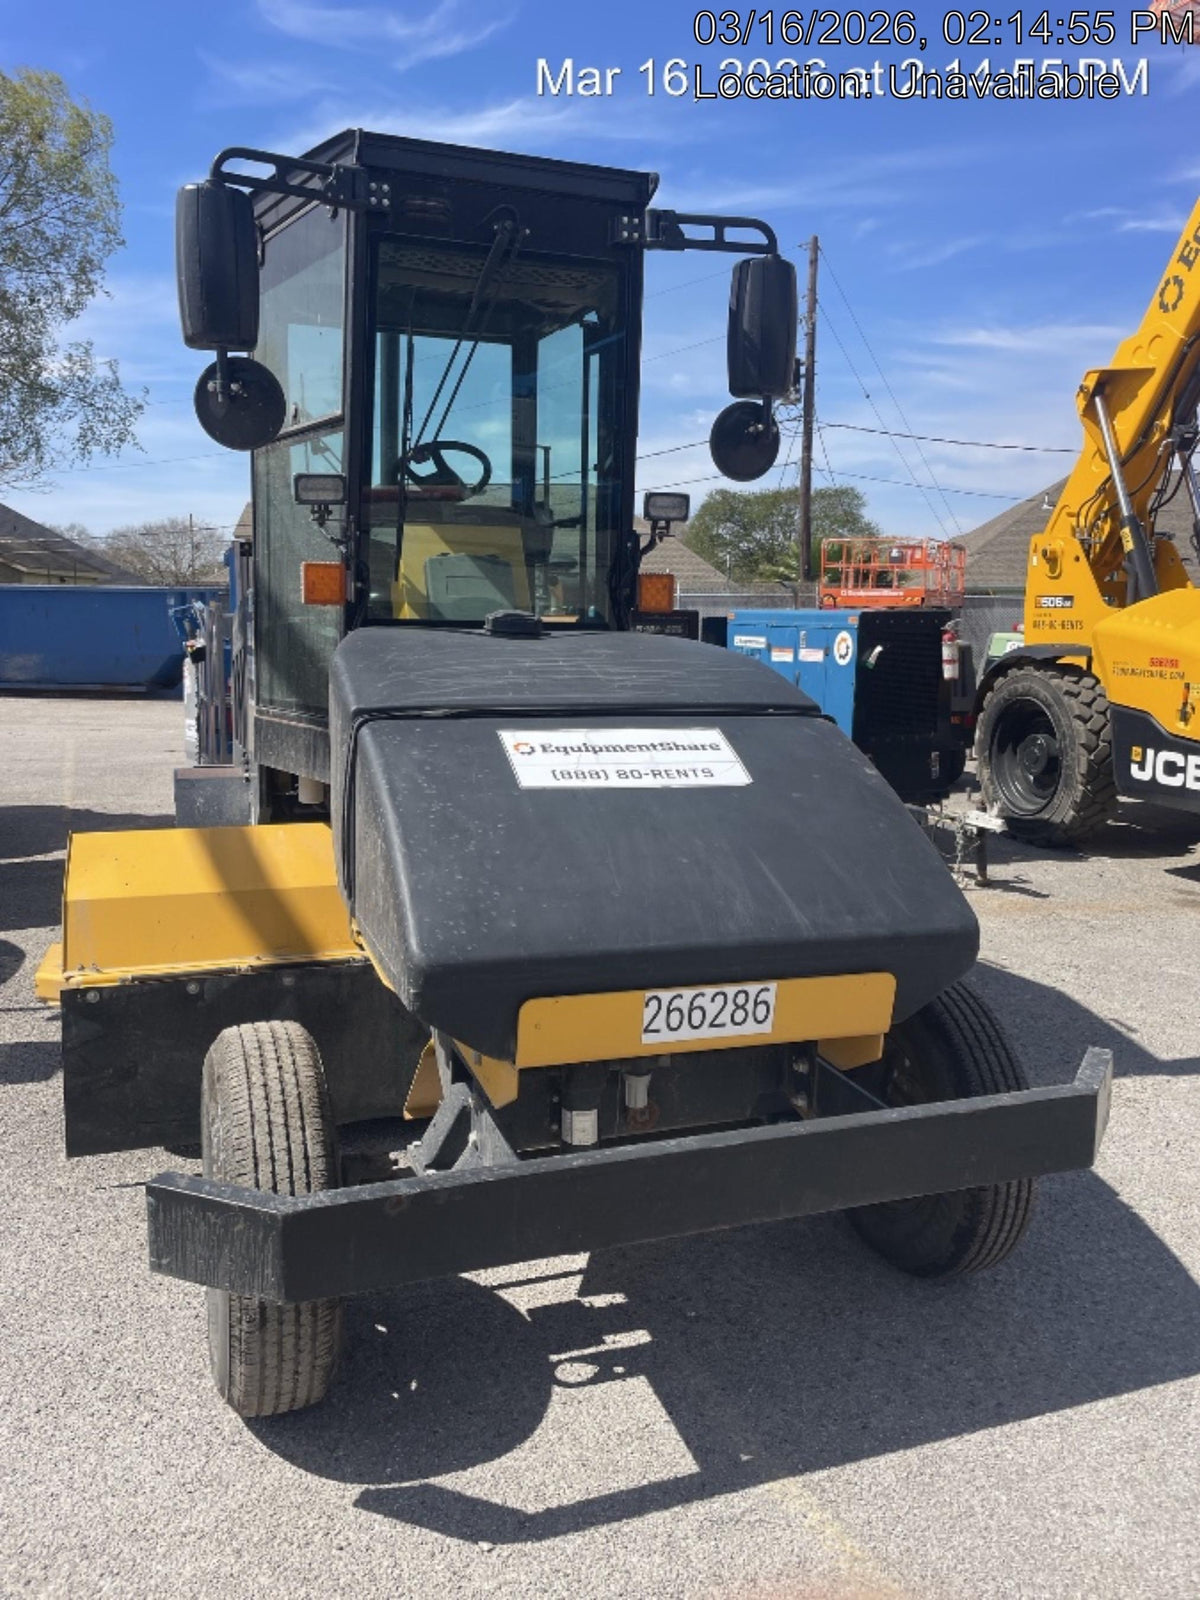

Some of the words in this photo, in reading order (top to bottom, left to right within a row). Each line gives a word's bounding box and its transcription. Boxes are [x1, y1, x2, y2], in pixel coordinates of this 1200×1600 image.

[540, 740, 722, 757] EquipmentShare
[550, 768, 609, 782] (888)
[616, 767, 715, 781] 80-RENTS
[643, 986, 771, 1034] 266286
